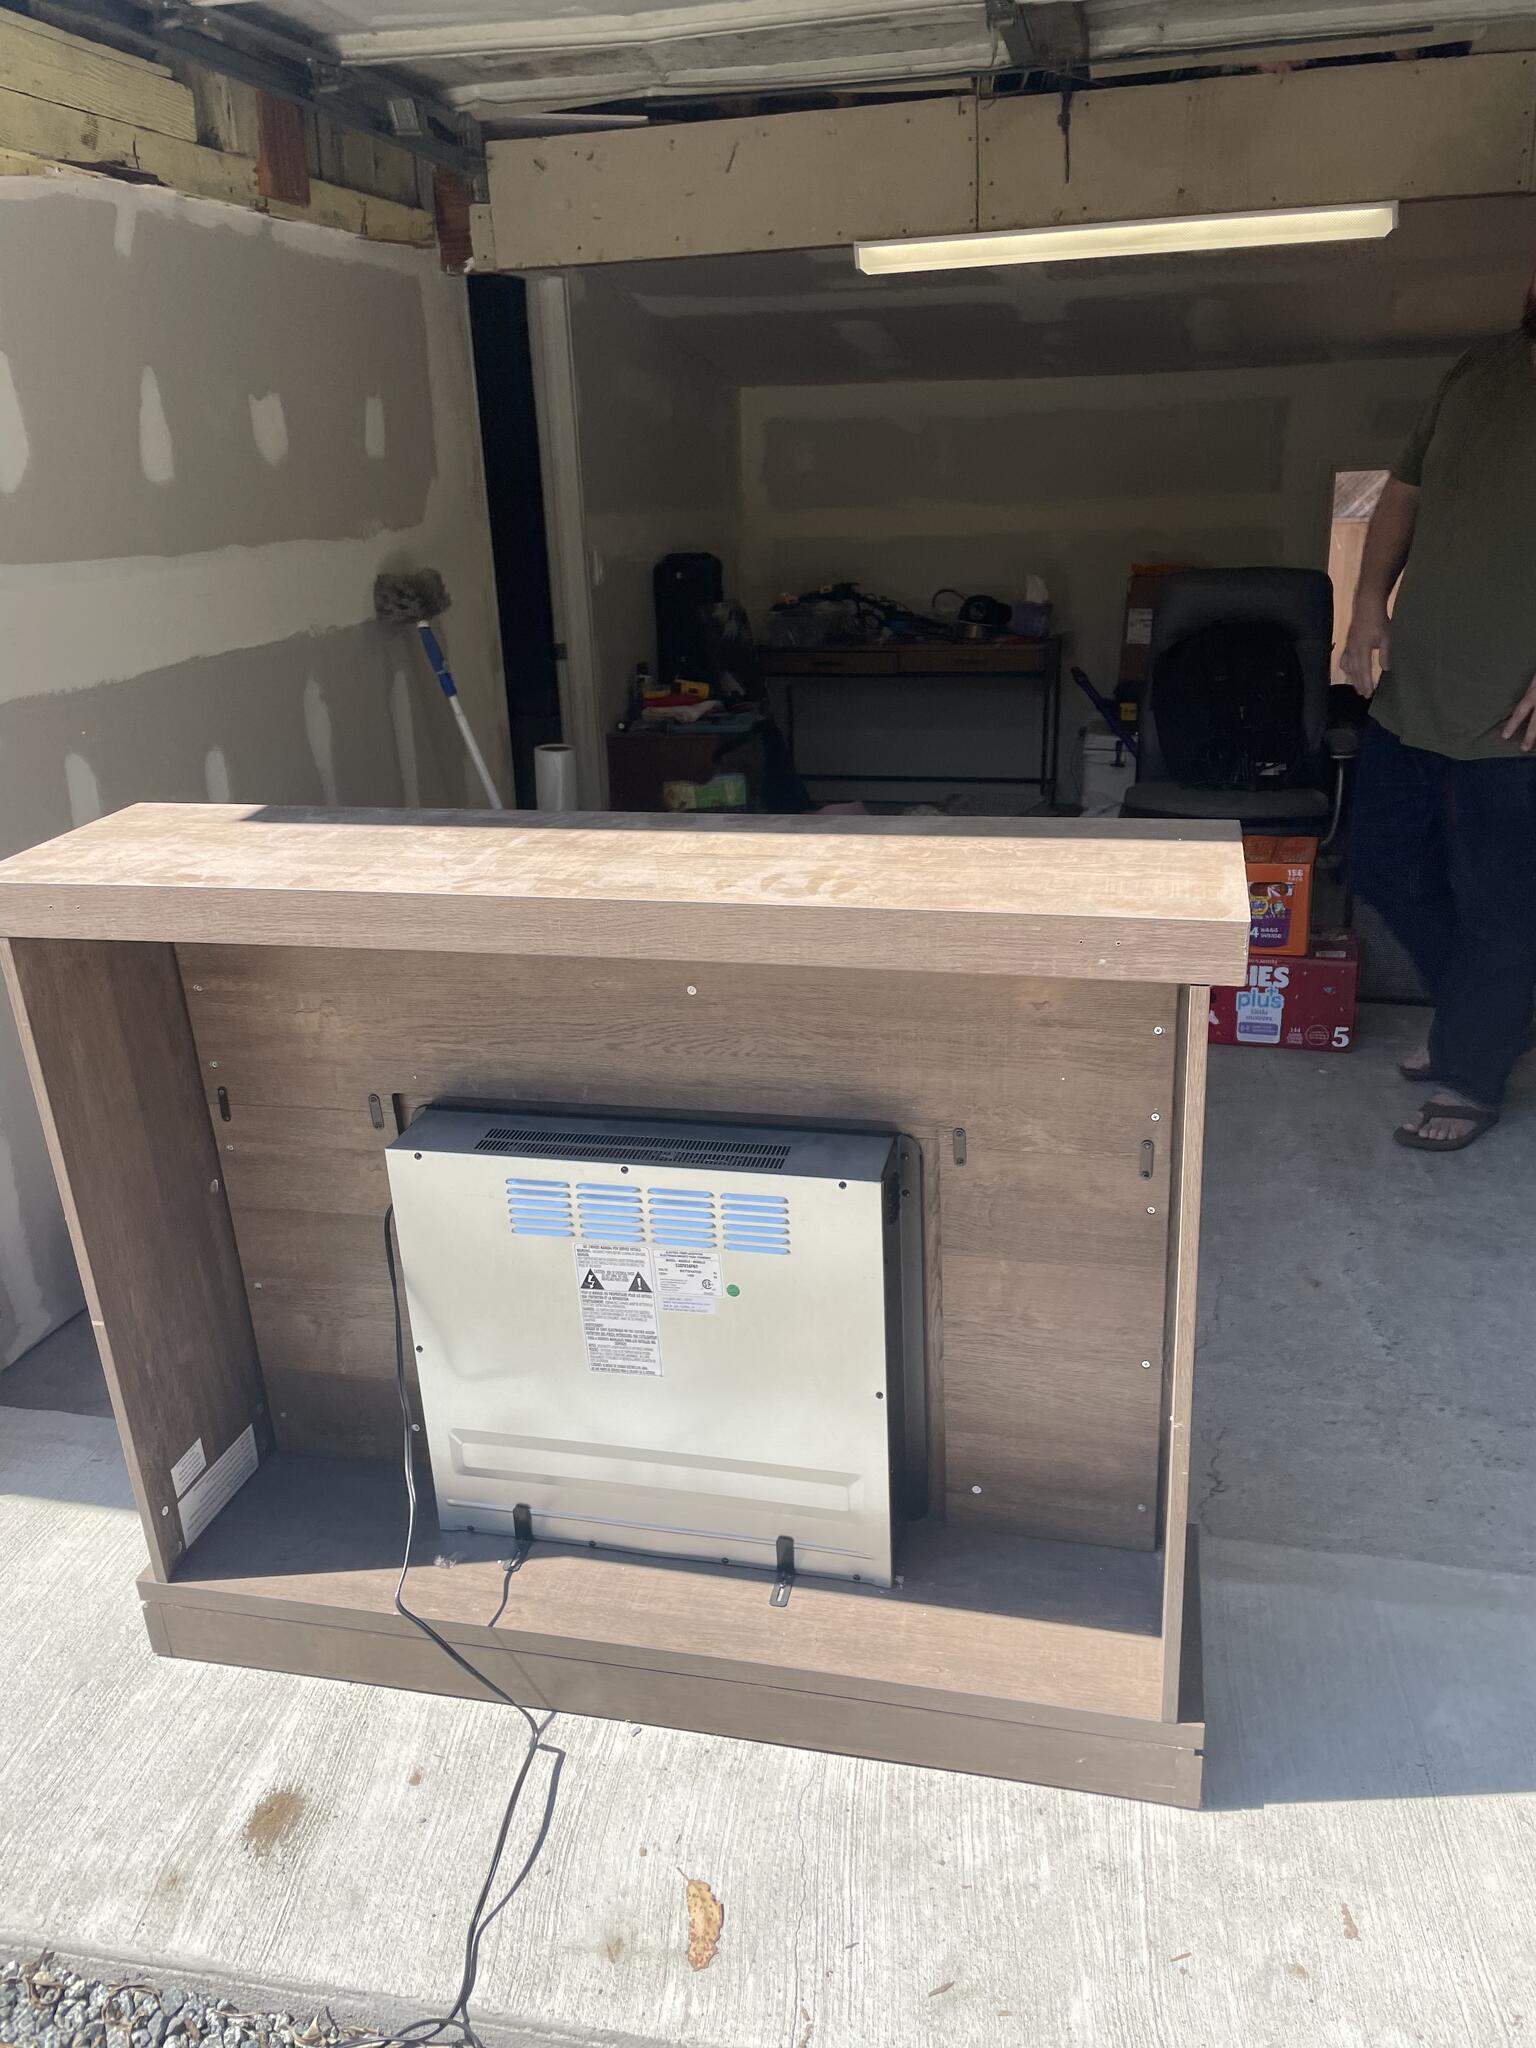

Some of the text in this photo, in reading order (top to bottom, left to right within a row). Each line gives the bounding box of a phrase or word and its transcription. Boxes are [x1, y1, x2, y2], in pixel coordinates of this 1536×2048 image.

[1250, 927, 1259, 938] 4
[1247, 965, 1290, 989] IES
[1237, 987, 1283, 1010] plus
[1331, 1026, 1350, 1048] 5
